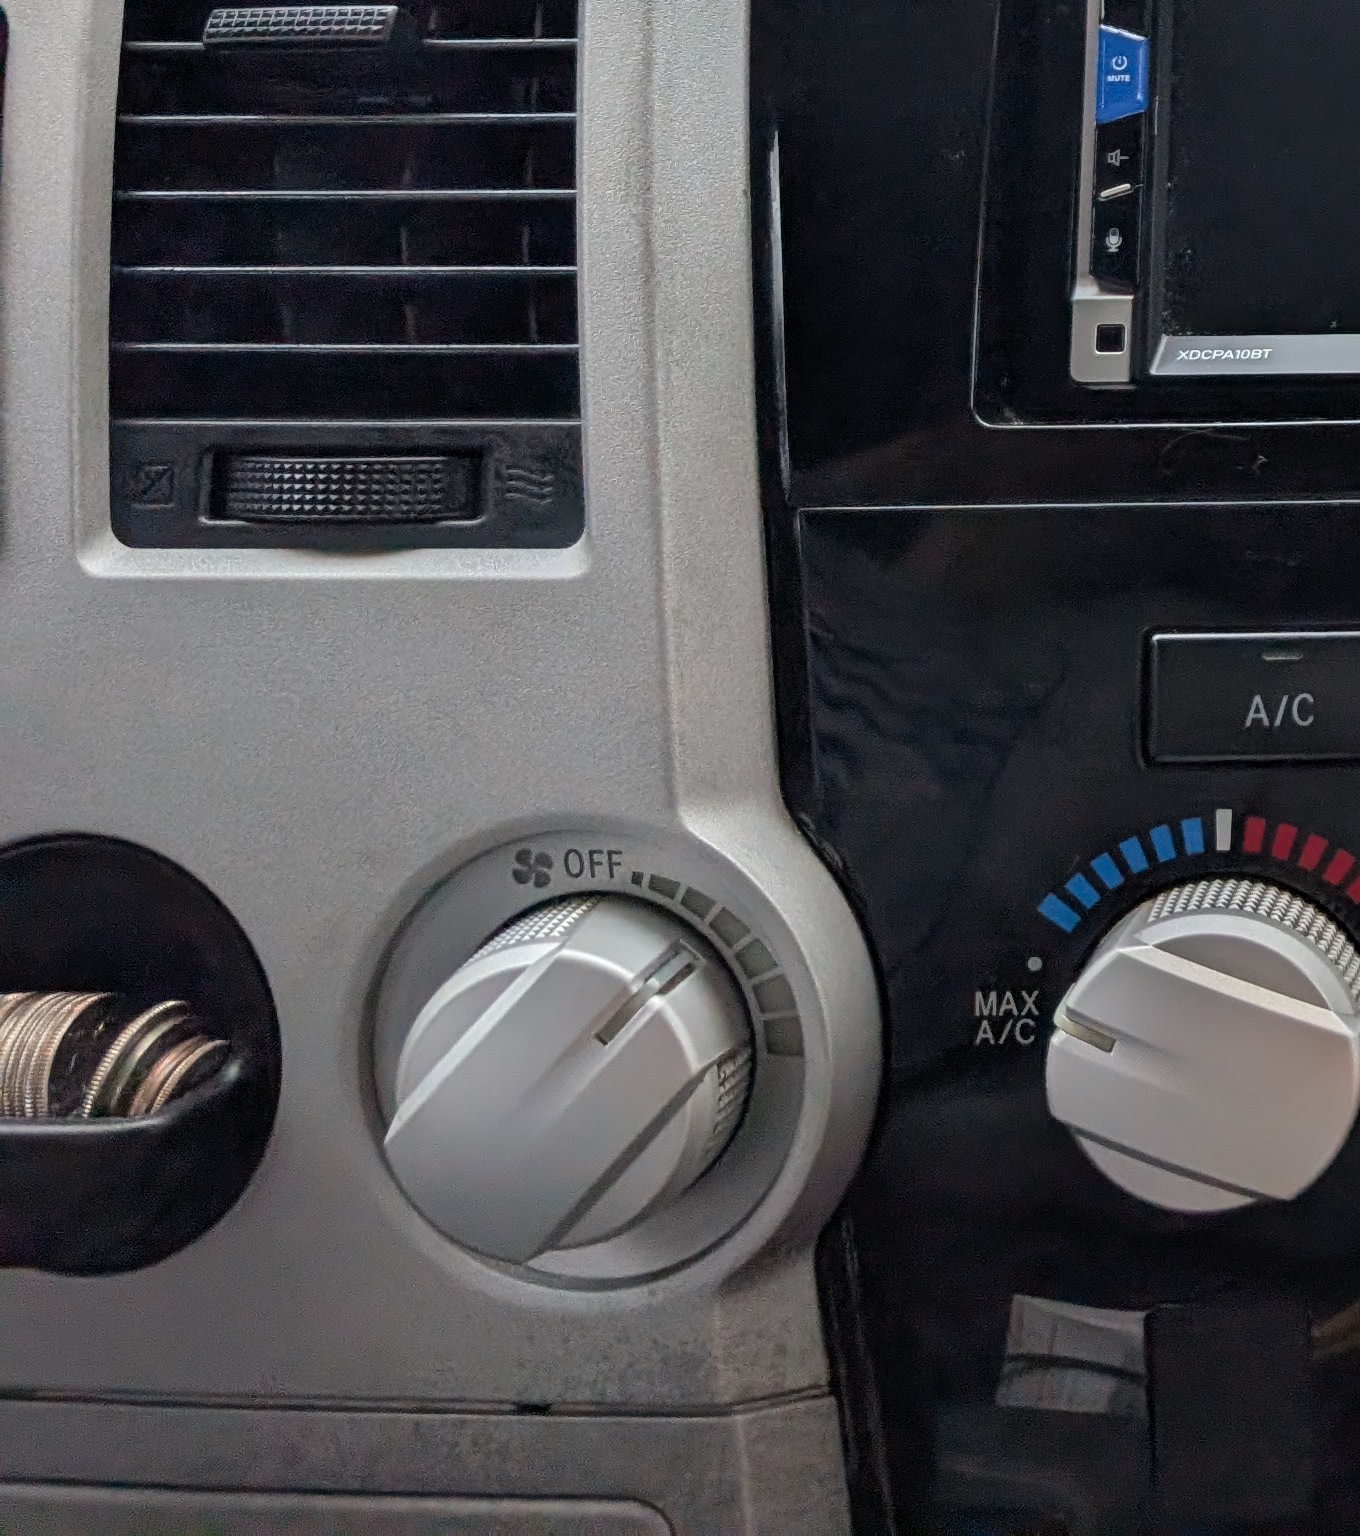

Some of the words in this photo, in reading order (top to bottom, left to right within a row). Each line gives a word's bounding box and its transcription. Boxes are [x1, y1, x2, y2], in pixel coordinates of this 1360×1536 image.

[1107, 74, 1131, 82] MUTE
[1177, 348, 1273, 360] XDCPA10BT
[1244, 692, 1315, 729] A/C
[563, 848, 623, 879] OFF
[974, 990, 1040, 1017] MAX
[975, 1018, 1036, 1045] A/C
